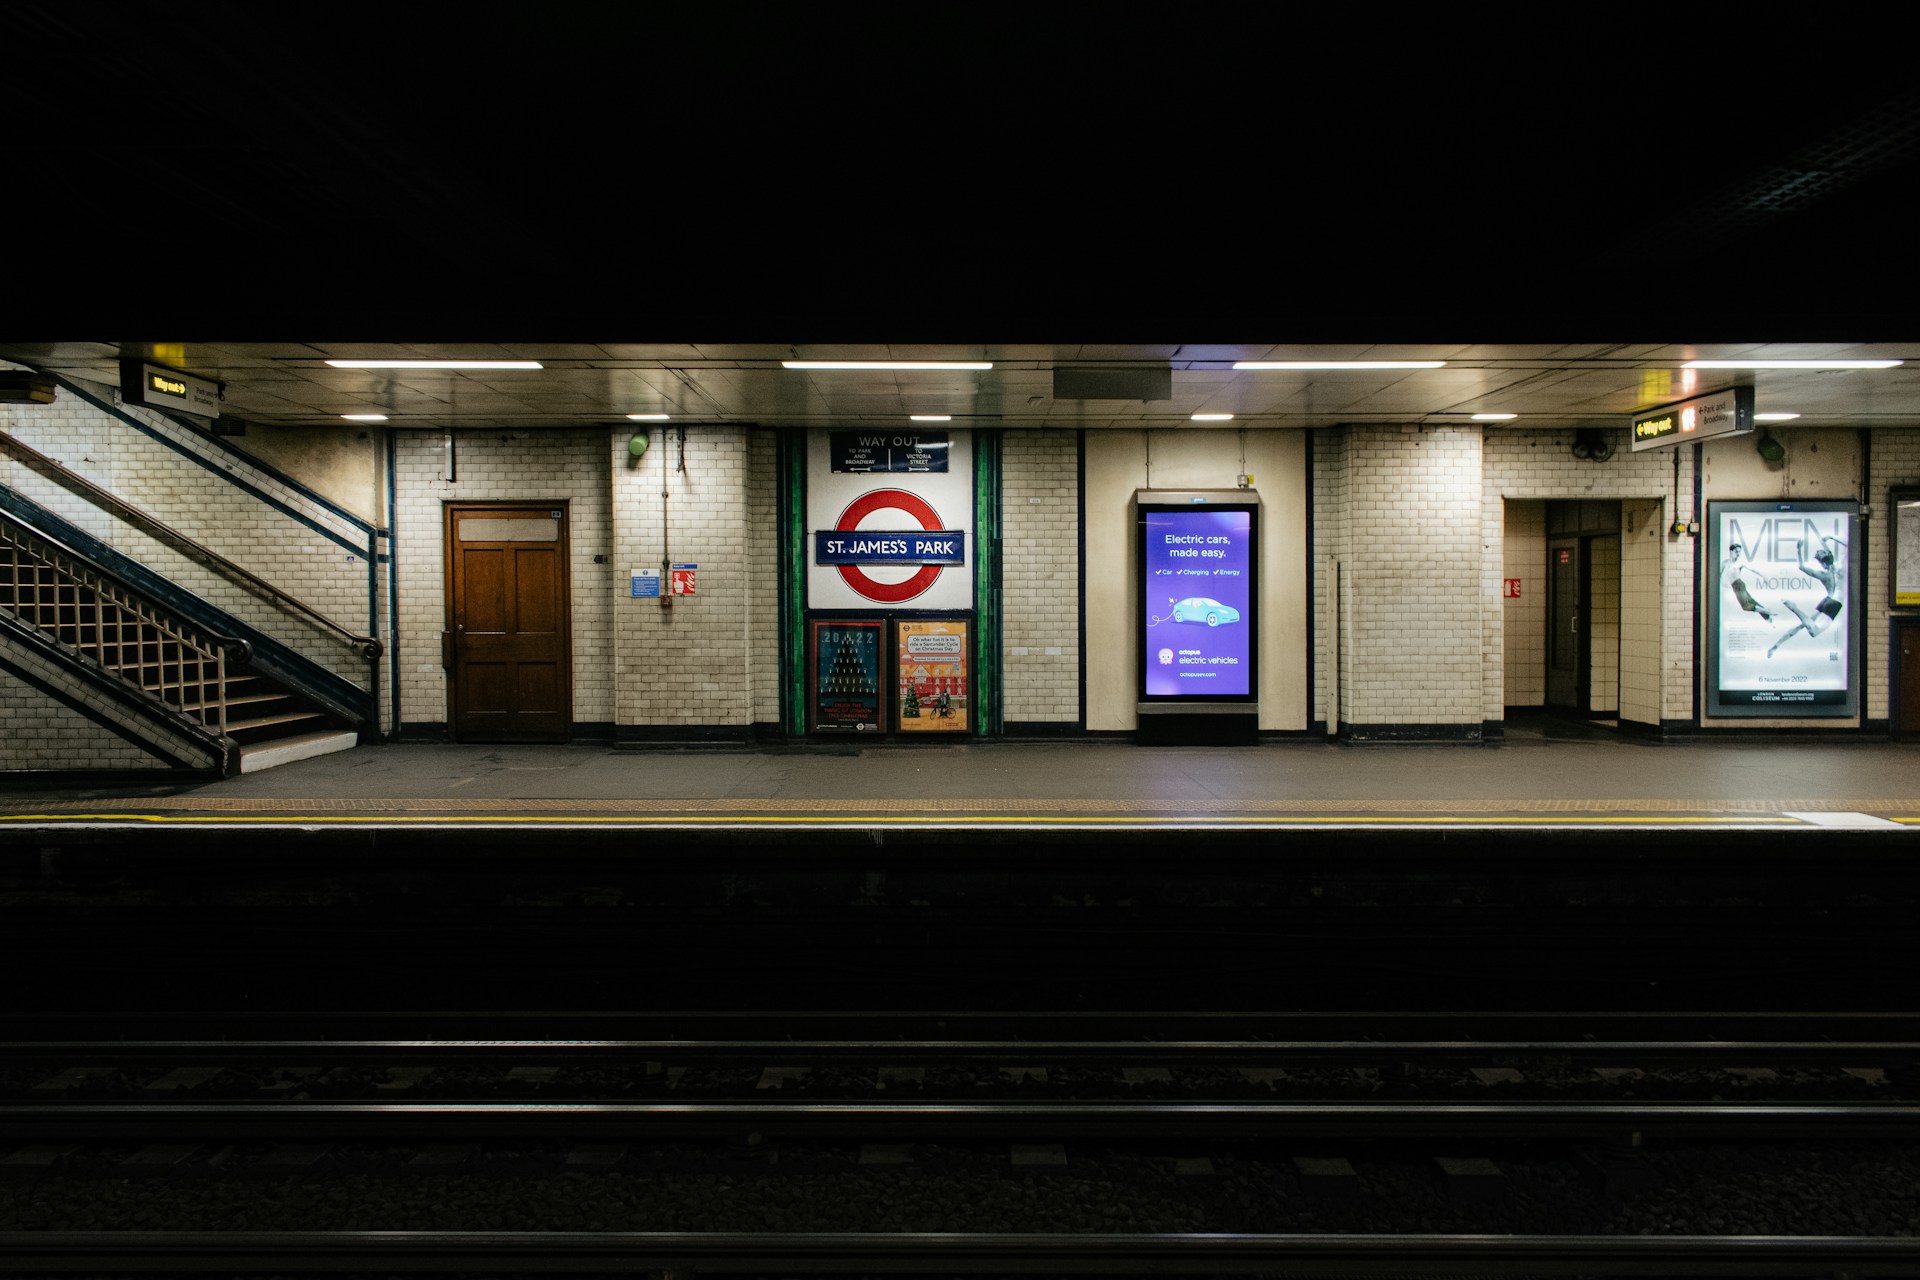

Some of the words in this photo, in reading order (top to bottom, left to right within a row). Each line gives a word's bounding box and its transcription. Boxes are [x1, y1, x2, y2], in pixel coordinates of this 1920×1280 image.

[1703, 405, 1715, 414] Park
[1716, 401, 1726, 411] and
[1704, 414, 1729, 425] Broadway
[1643, 420, 1658, 435] Way
[1658, 417, 1672, 432] out
[858, 437, 886, 447] WAY
[893, 437, 921, 447] OUT
[1165, 535, 1204, 544] Electric
[1206, 536, 1231, 545] cars,
[1729, 518, 1839, 563] MEN
[827, 540, 846, 554] ST.
[849, 539, 908, 555] JAMES'S
[916, 540, 954, 554] PARK
[1169, 548, 1199, 557] made
[1201, 549, 1226, 559] easy.
[1756, 577, 1812, 590] MOTION
[1207, 656, 1239, 664] vehicles
